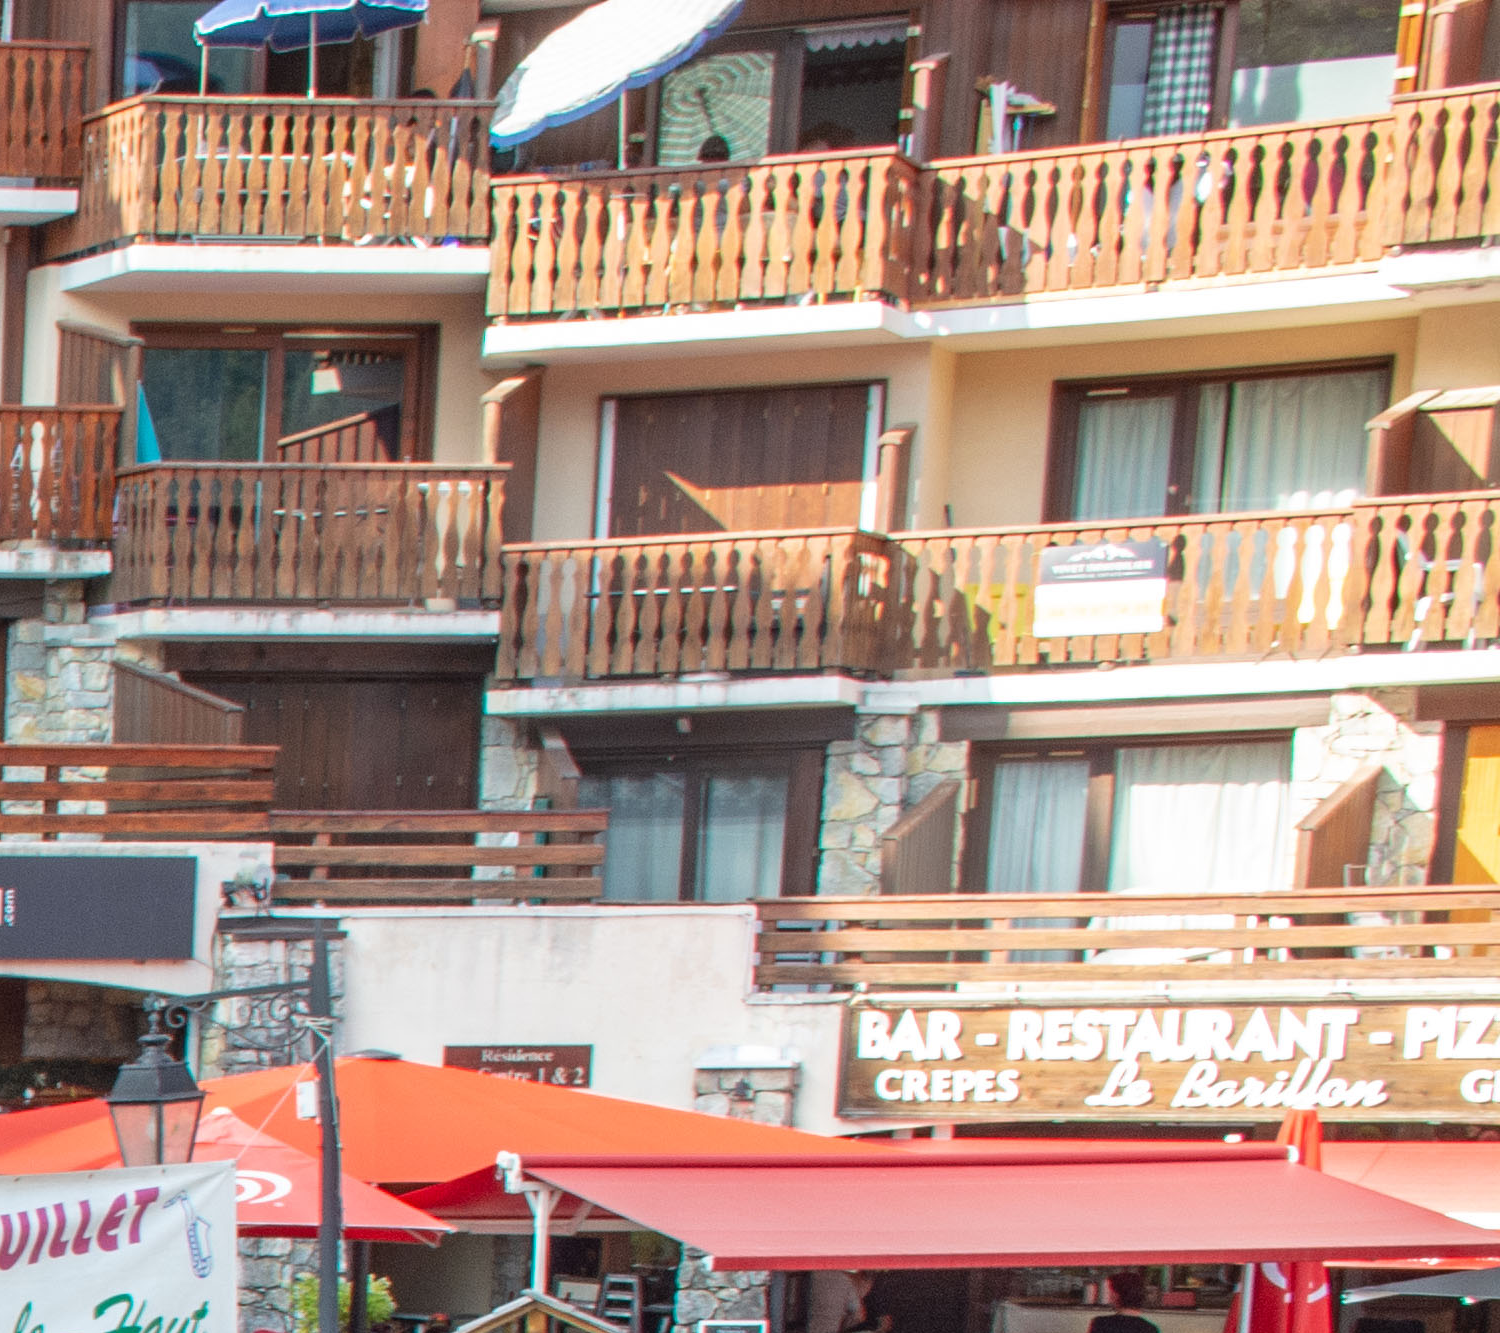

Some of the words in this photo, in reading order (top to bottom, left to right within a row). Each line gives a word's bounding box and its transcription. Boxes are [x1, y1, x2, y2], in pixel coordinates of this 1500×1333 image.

[858, 1007, 964, 1062] BAR
[1007, 1007, 1359, 1062] RESTAURANT
[572, 1067, 586, 1084] 2
[875, 1069, 1020, 1103] CREPES
[1084, 1058, 1154, 1107] Le
